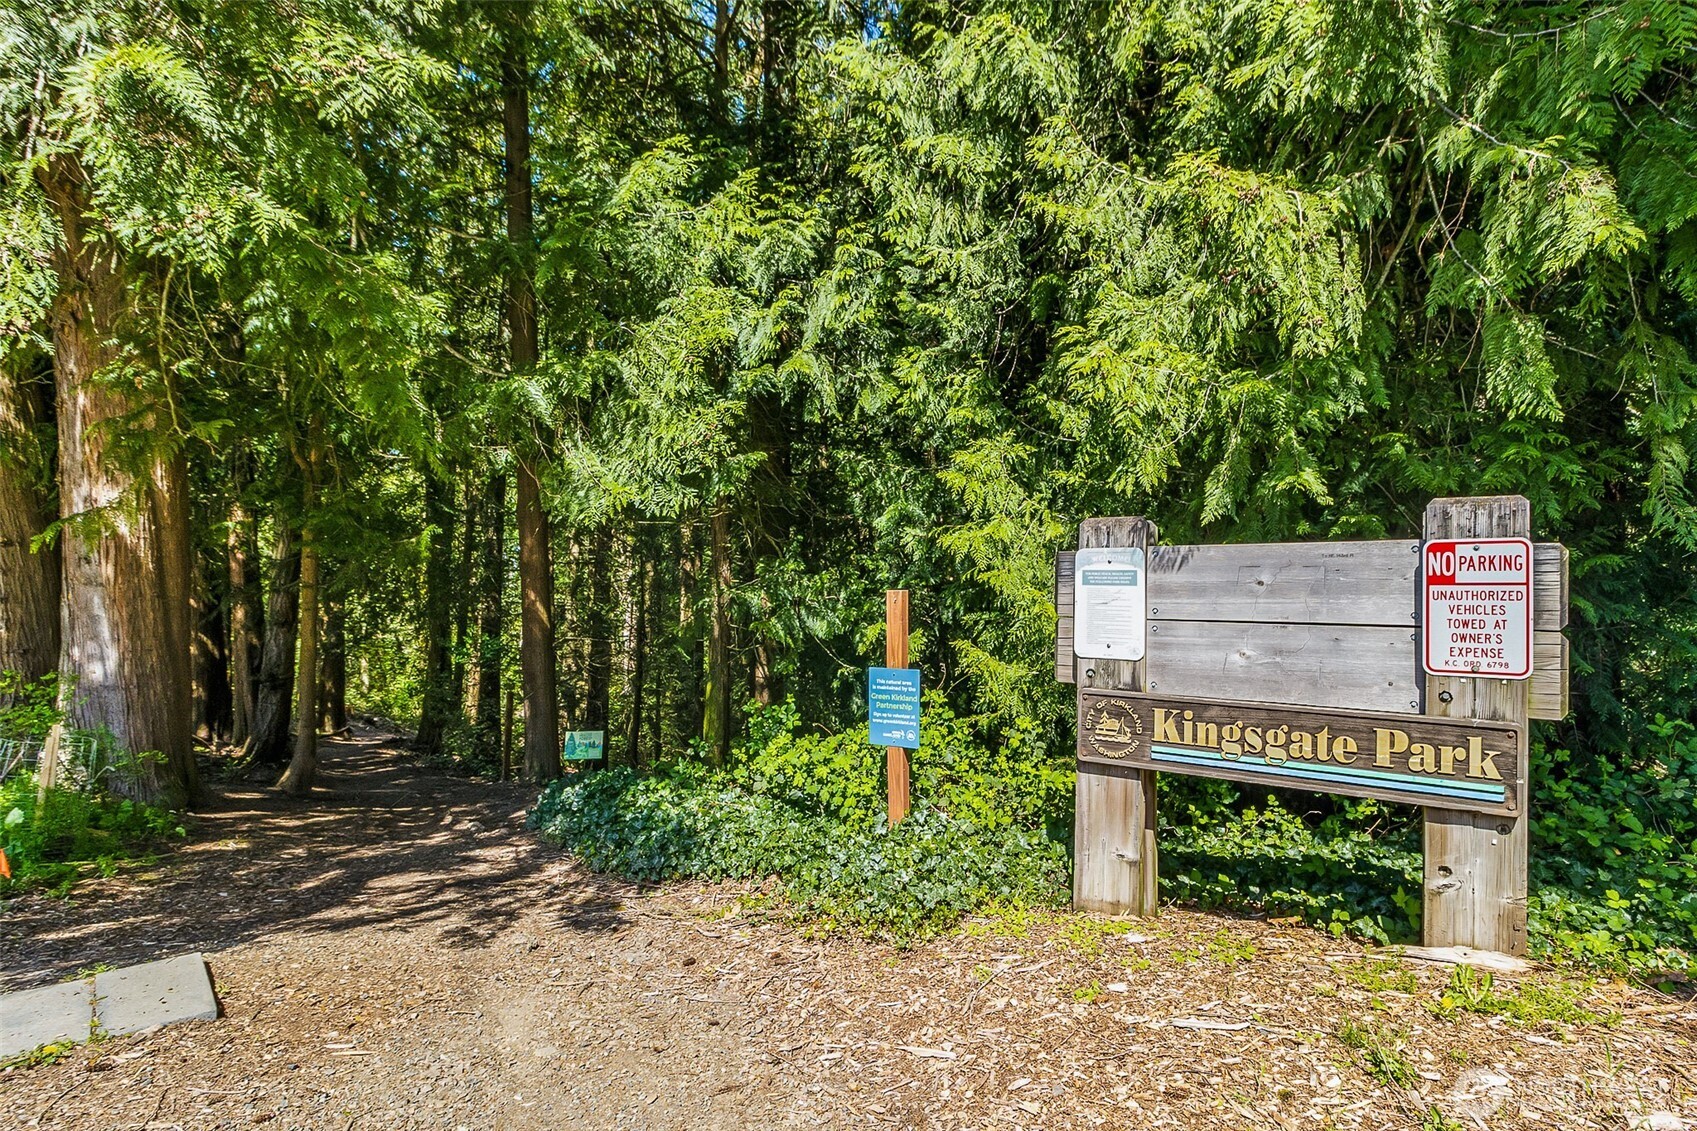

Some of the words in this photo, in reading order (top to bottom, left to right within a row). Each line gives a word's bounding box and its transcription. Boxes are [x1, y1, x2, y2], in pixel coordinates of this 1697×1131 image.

[1428, 552, 1455, 577] NO
[1459, 555, 1523, 572] PARKING
[1432, 590, 1524, 601] UNAUTHORIZED
[1448, 604, 1507, 615] VEHICLES
[1446, 619, 1486, 630] TOWED
[1494, 619, 1508, 630] AT
[1451, 633, 1503, 644] OWNER'S
[1449, 647, 1505, 659] EXPENSE
[1487, 661, 1510, 669] 6798
[891, 694, 918, 702] Kirkland
[876, 701, 913, 711] Partnership
[1085, 708, 1095, 729] CITY
[1096, 699, 1108, 709] OF
[1111, 699, 1143, 734] KIRKLAND
[1088, 734, 1140, 758] WASHINGTON
[1151, 707, 1358, 766] Kingsgate
[1372, 728, 1503, 780] Park
